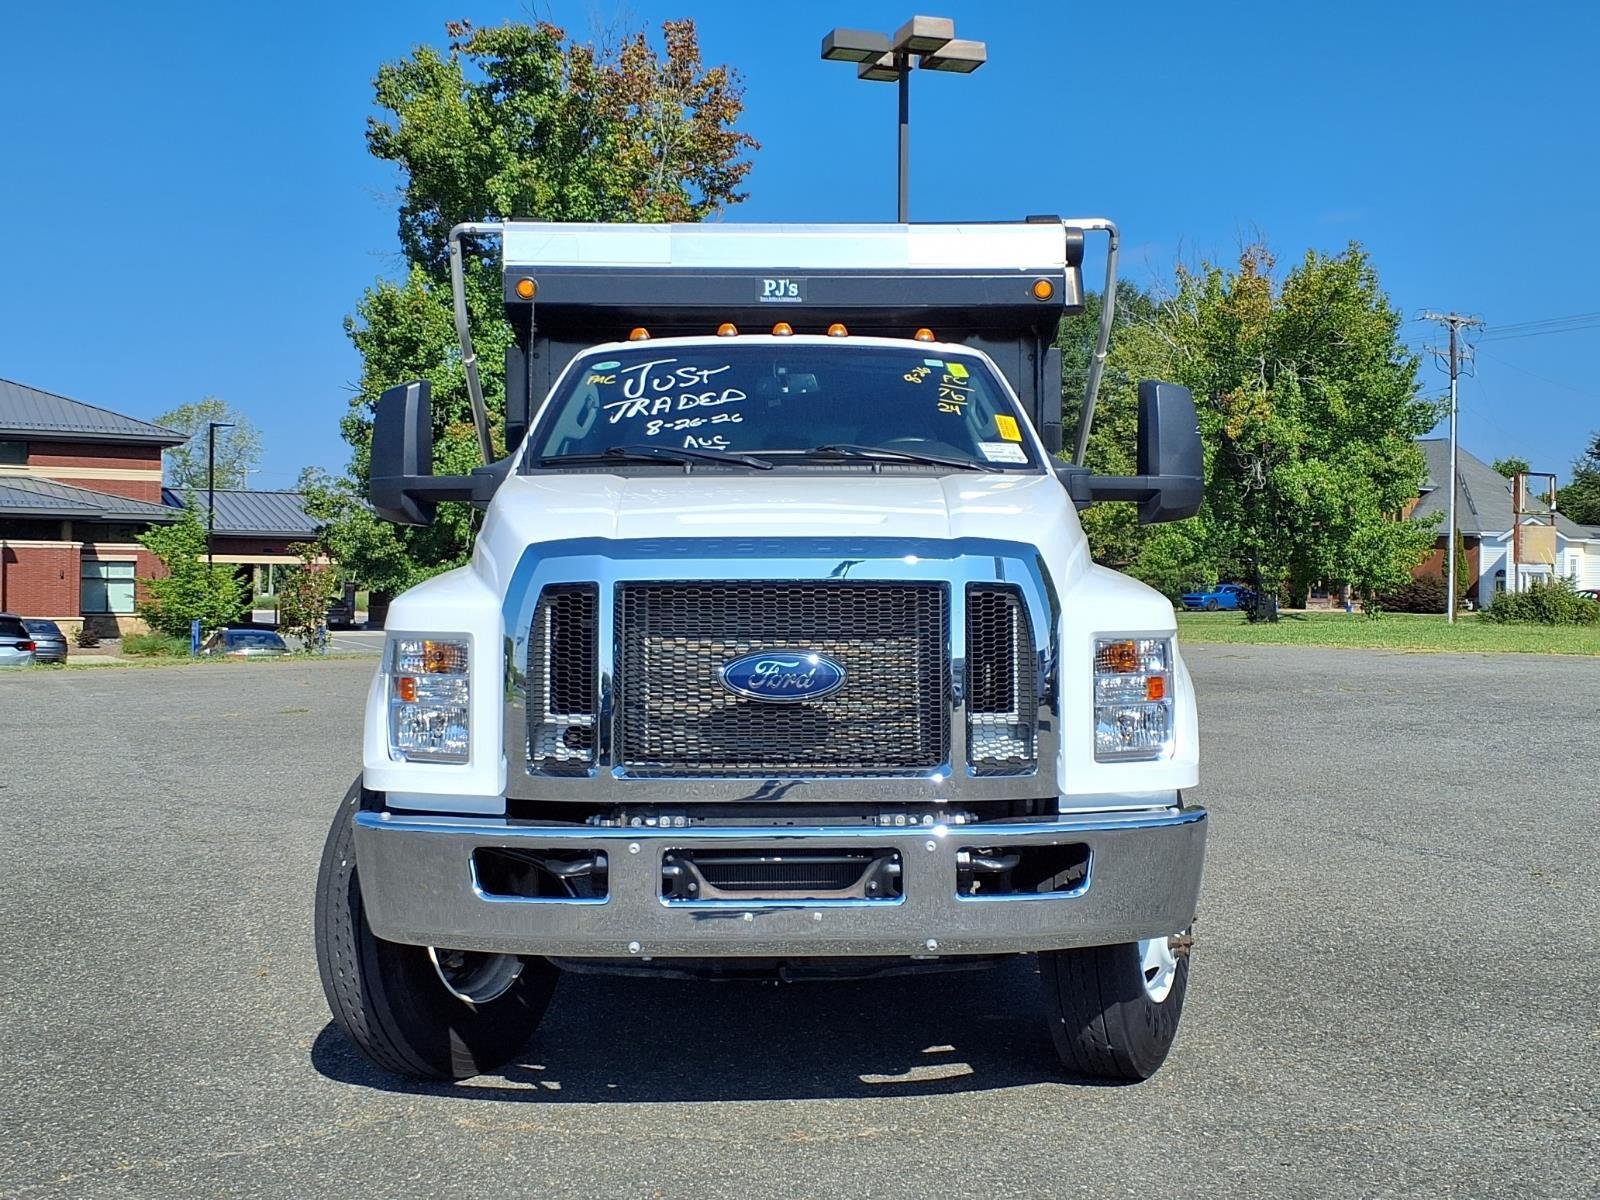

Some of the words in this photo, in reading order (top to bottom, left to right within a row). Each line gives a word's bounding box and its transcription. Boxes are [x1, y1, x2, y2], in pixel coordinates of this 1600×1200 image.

[763, 279, 799, 296] PJ's
[603, 388, 747, 424] TRADED
[748, 660, 816, 689] Ford
